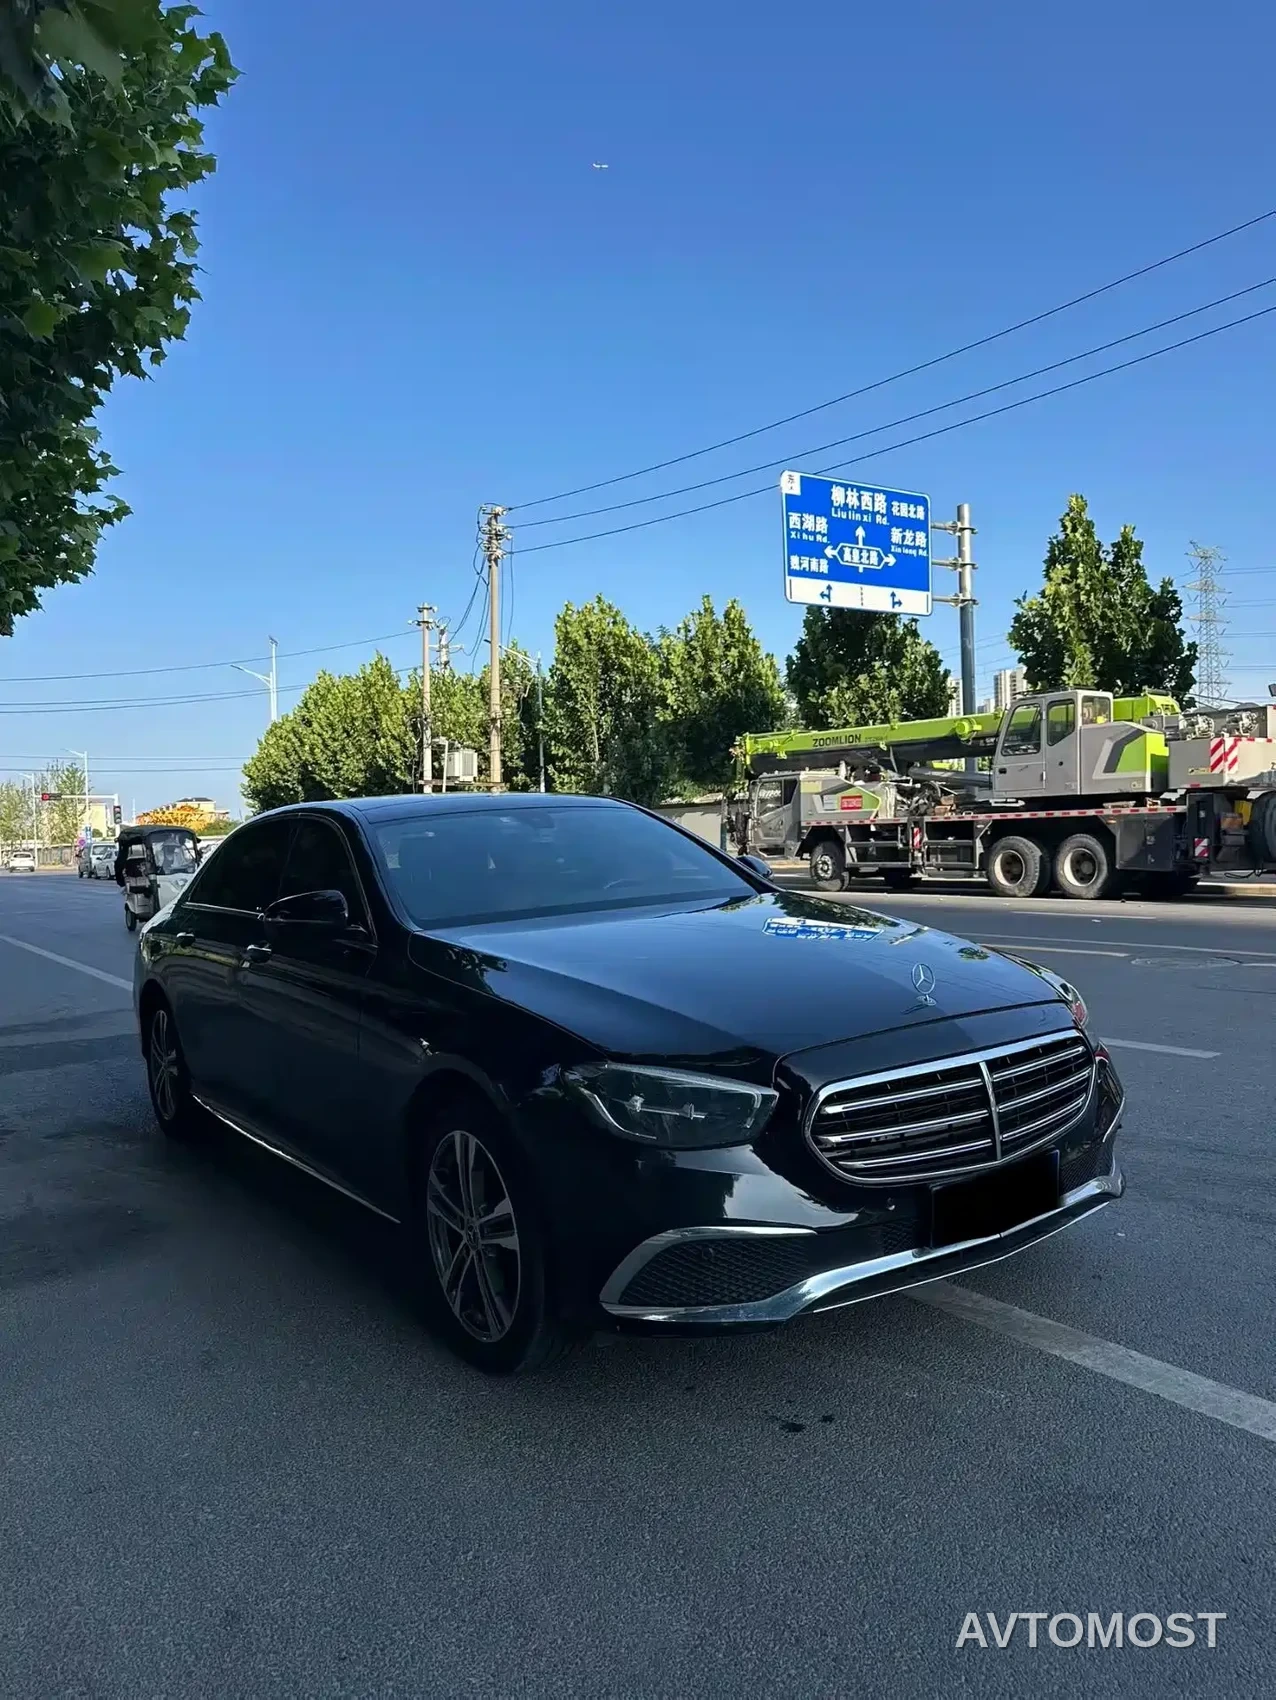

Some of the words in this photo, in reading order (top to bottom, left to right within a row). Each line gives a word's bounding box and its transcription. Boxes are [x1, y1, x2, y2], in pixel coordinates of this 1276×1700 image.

[830, 484, 887, 514] 柳林西路
[788, 512, 828, 534] 西湖路
[876, 514, 890, 525] Rd.
[891, 527, 927, 548] 新龙路
[812, 734, 861, 747] ZOOMLION
